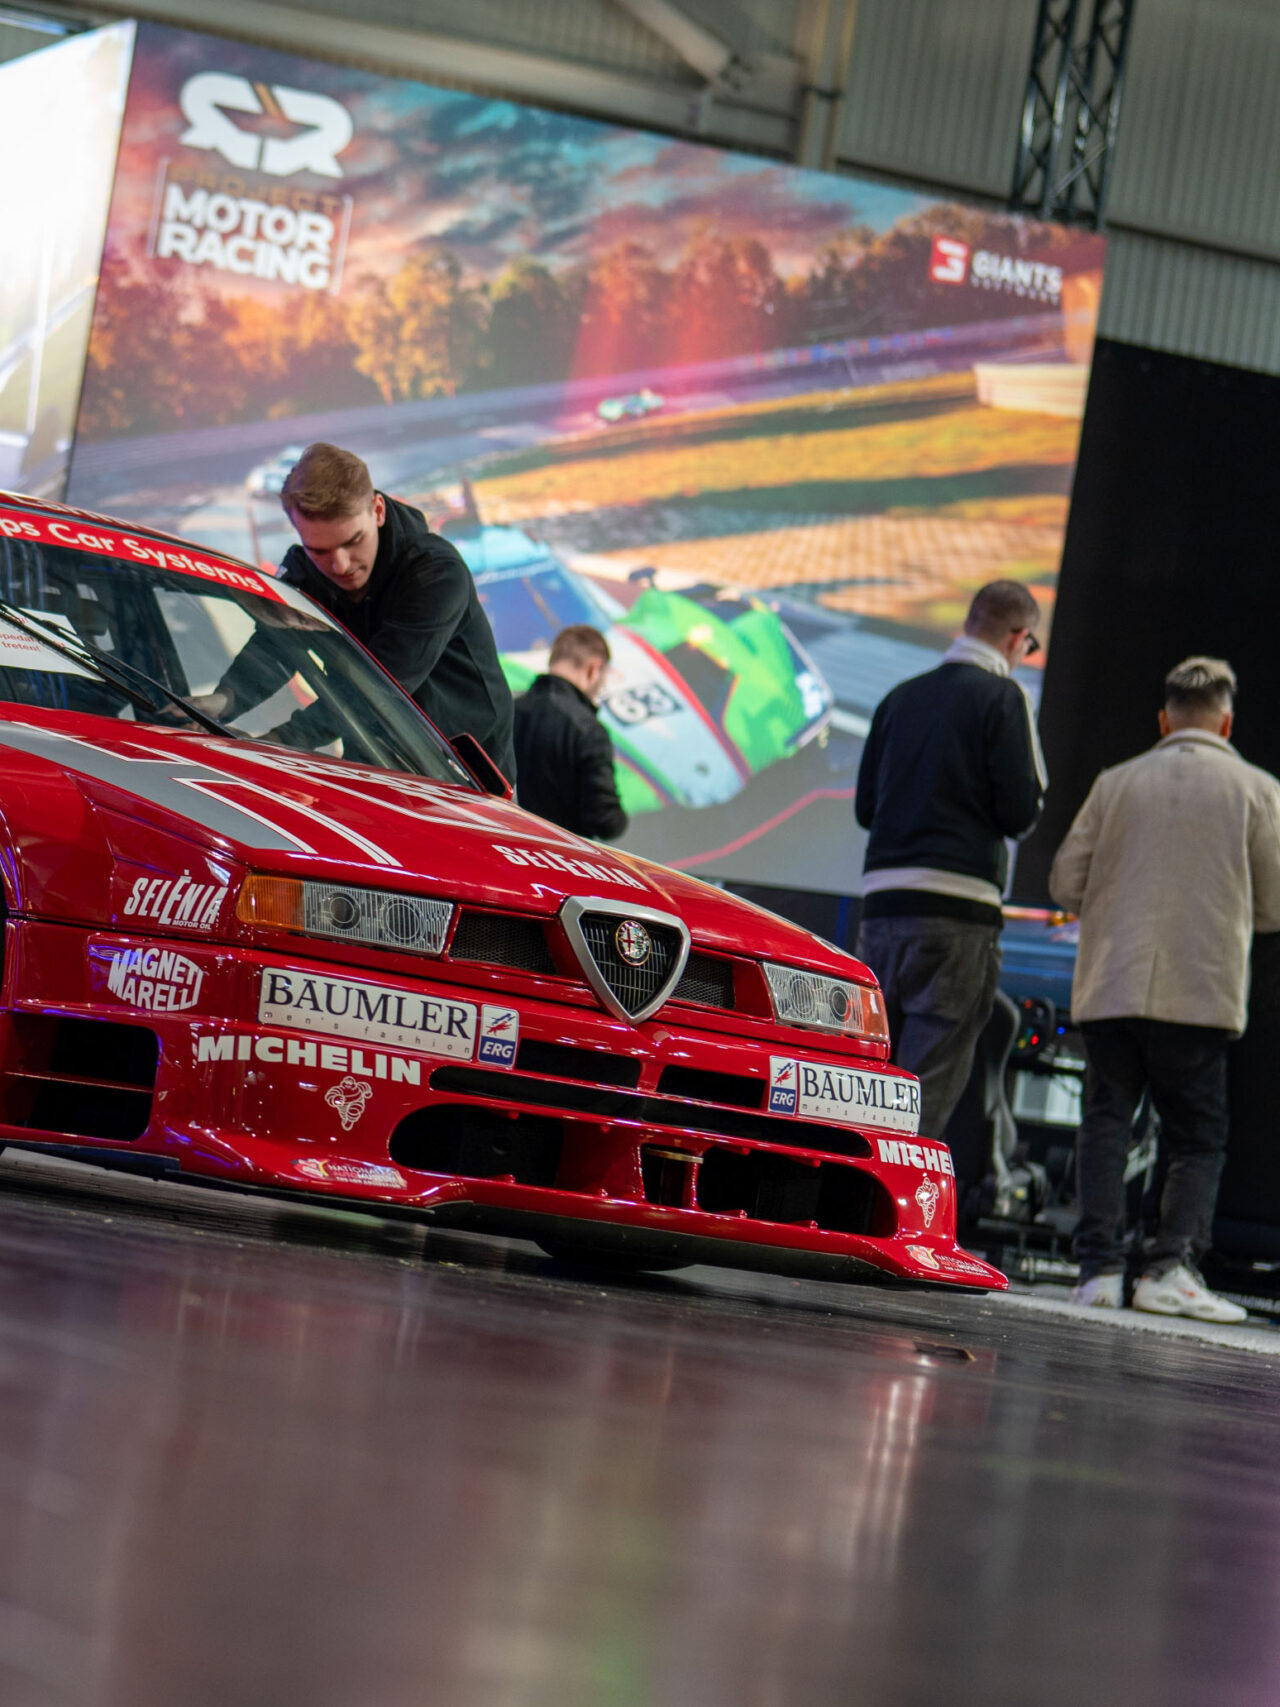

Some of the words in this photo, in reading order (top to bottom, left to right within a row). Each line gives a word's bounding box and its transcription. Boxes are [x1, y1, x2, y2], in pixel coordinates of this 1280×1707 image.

[164, 182, 335, 255] MOTOR
[157, 219, 331, 291] RACING
[972, 249, 1063, 295] GIANTS
[47, 522, 115, 552] Car
[122, 537, 266, 593] Systems
[172, 919, 199, 929] MOTOR
[199, 922, 212, 931] OIL
[198, 1035, 421, 1086] MICHELIN
[364, 1025, 471, 1055] fashion
[482, 1040, 515, 1059] ERG
[772, 1091, 796, 1107] ERG
